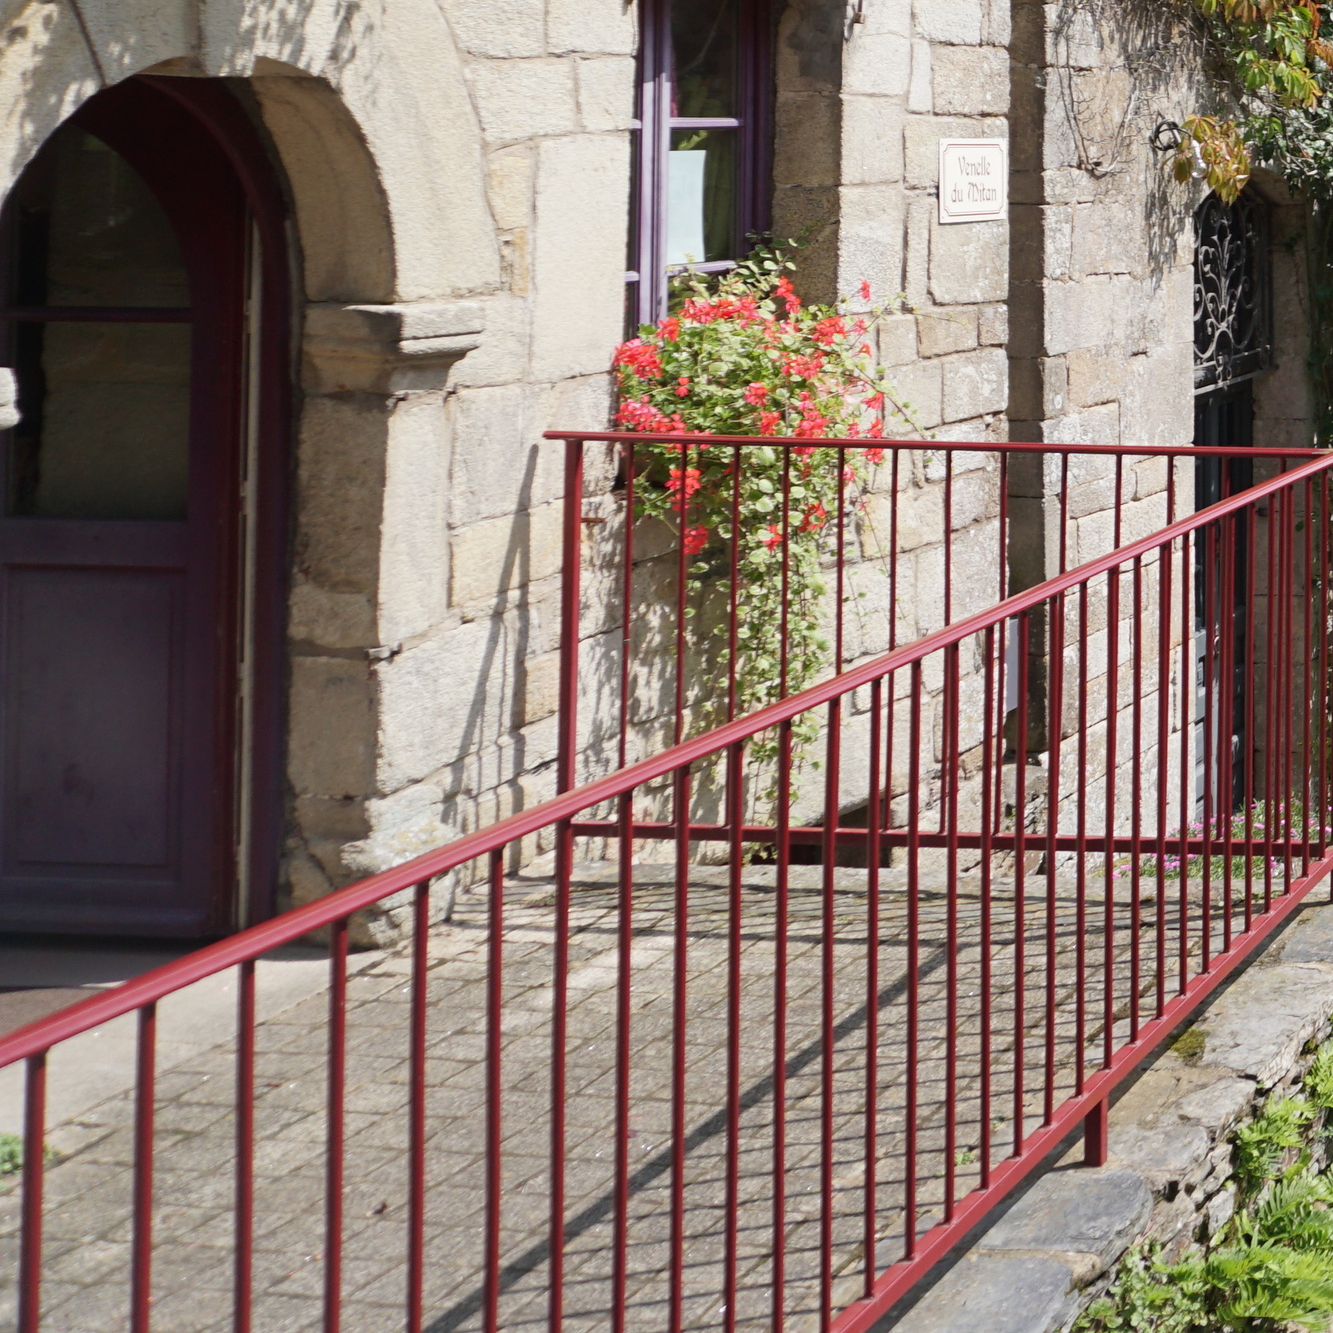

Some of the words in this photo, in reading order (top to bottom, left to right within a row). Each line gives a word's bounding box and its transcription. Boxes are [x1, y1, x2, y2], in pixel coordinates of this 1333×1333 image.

[957, 156, 991, 176] Venelle
[951, 182, 964, 202] du
[967, 181, 997, 202] Mitan
